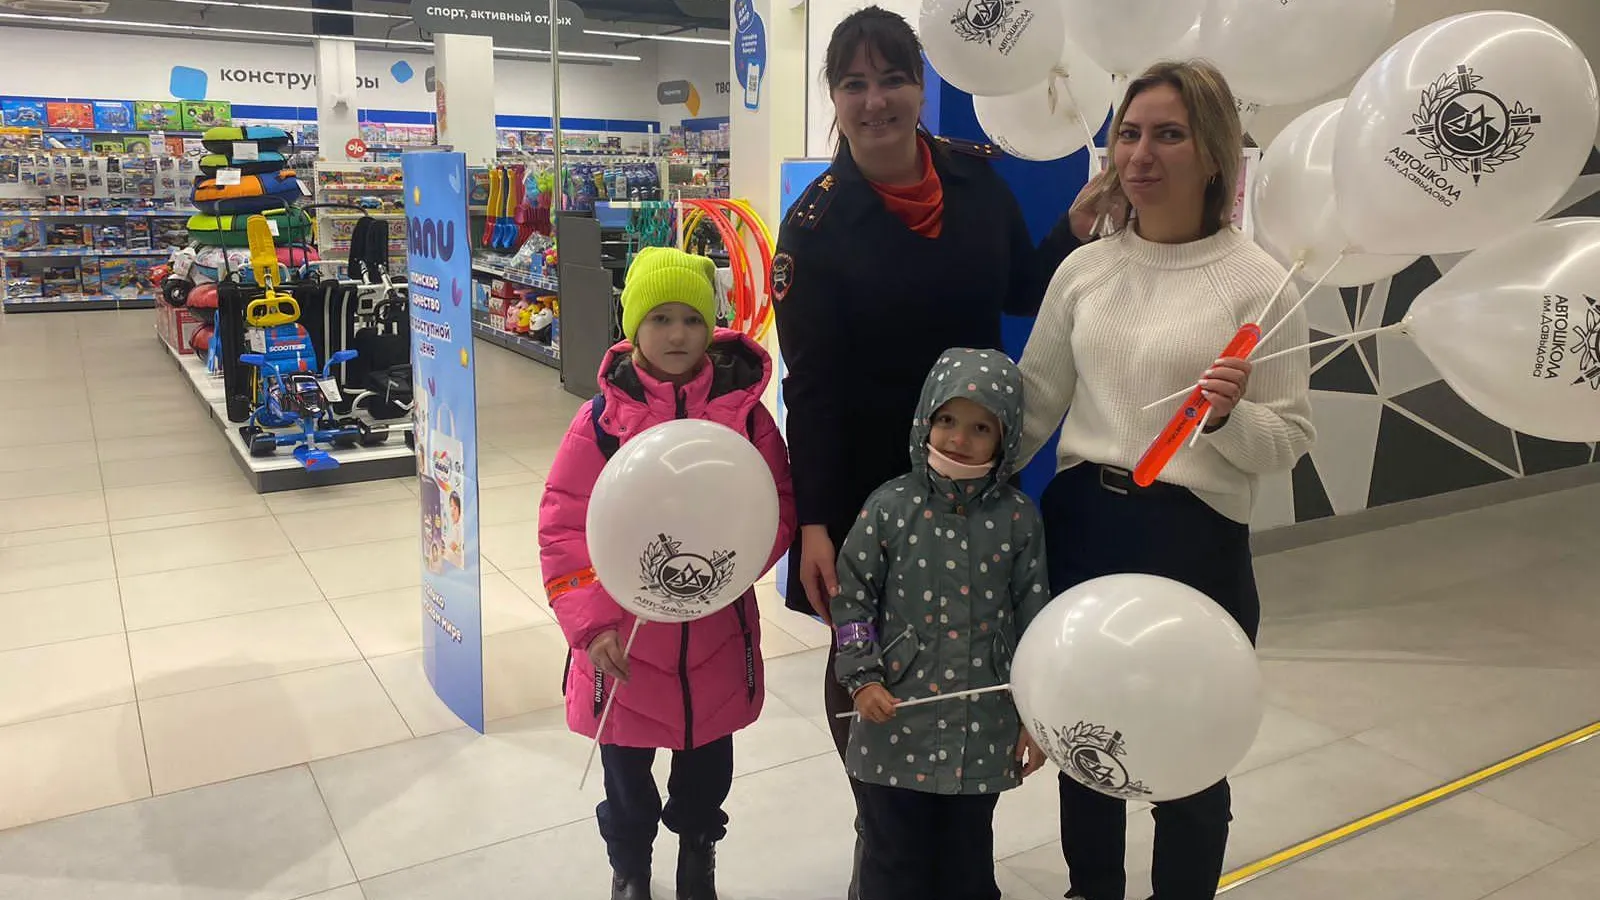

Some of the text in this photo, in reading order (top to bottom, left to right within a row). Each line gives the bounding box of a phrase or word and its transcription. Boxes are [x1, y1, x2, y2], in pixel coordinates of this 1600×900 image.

[426, 6, 572, 26] спорт, активный отых
[220, 68, 379, 90] конструы
[1389, 146, 1462, 201] АВТОШКОЛА
[1544, 294, 1569, 379] АВТОШКОЛА
[594, 666, 604, 703] UTURINO
